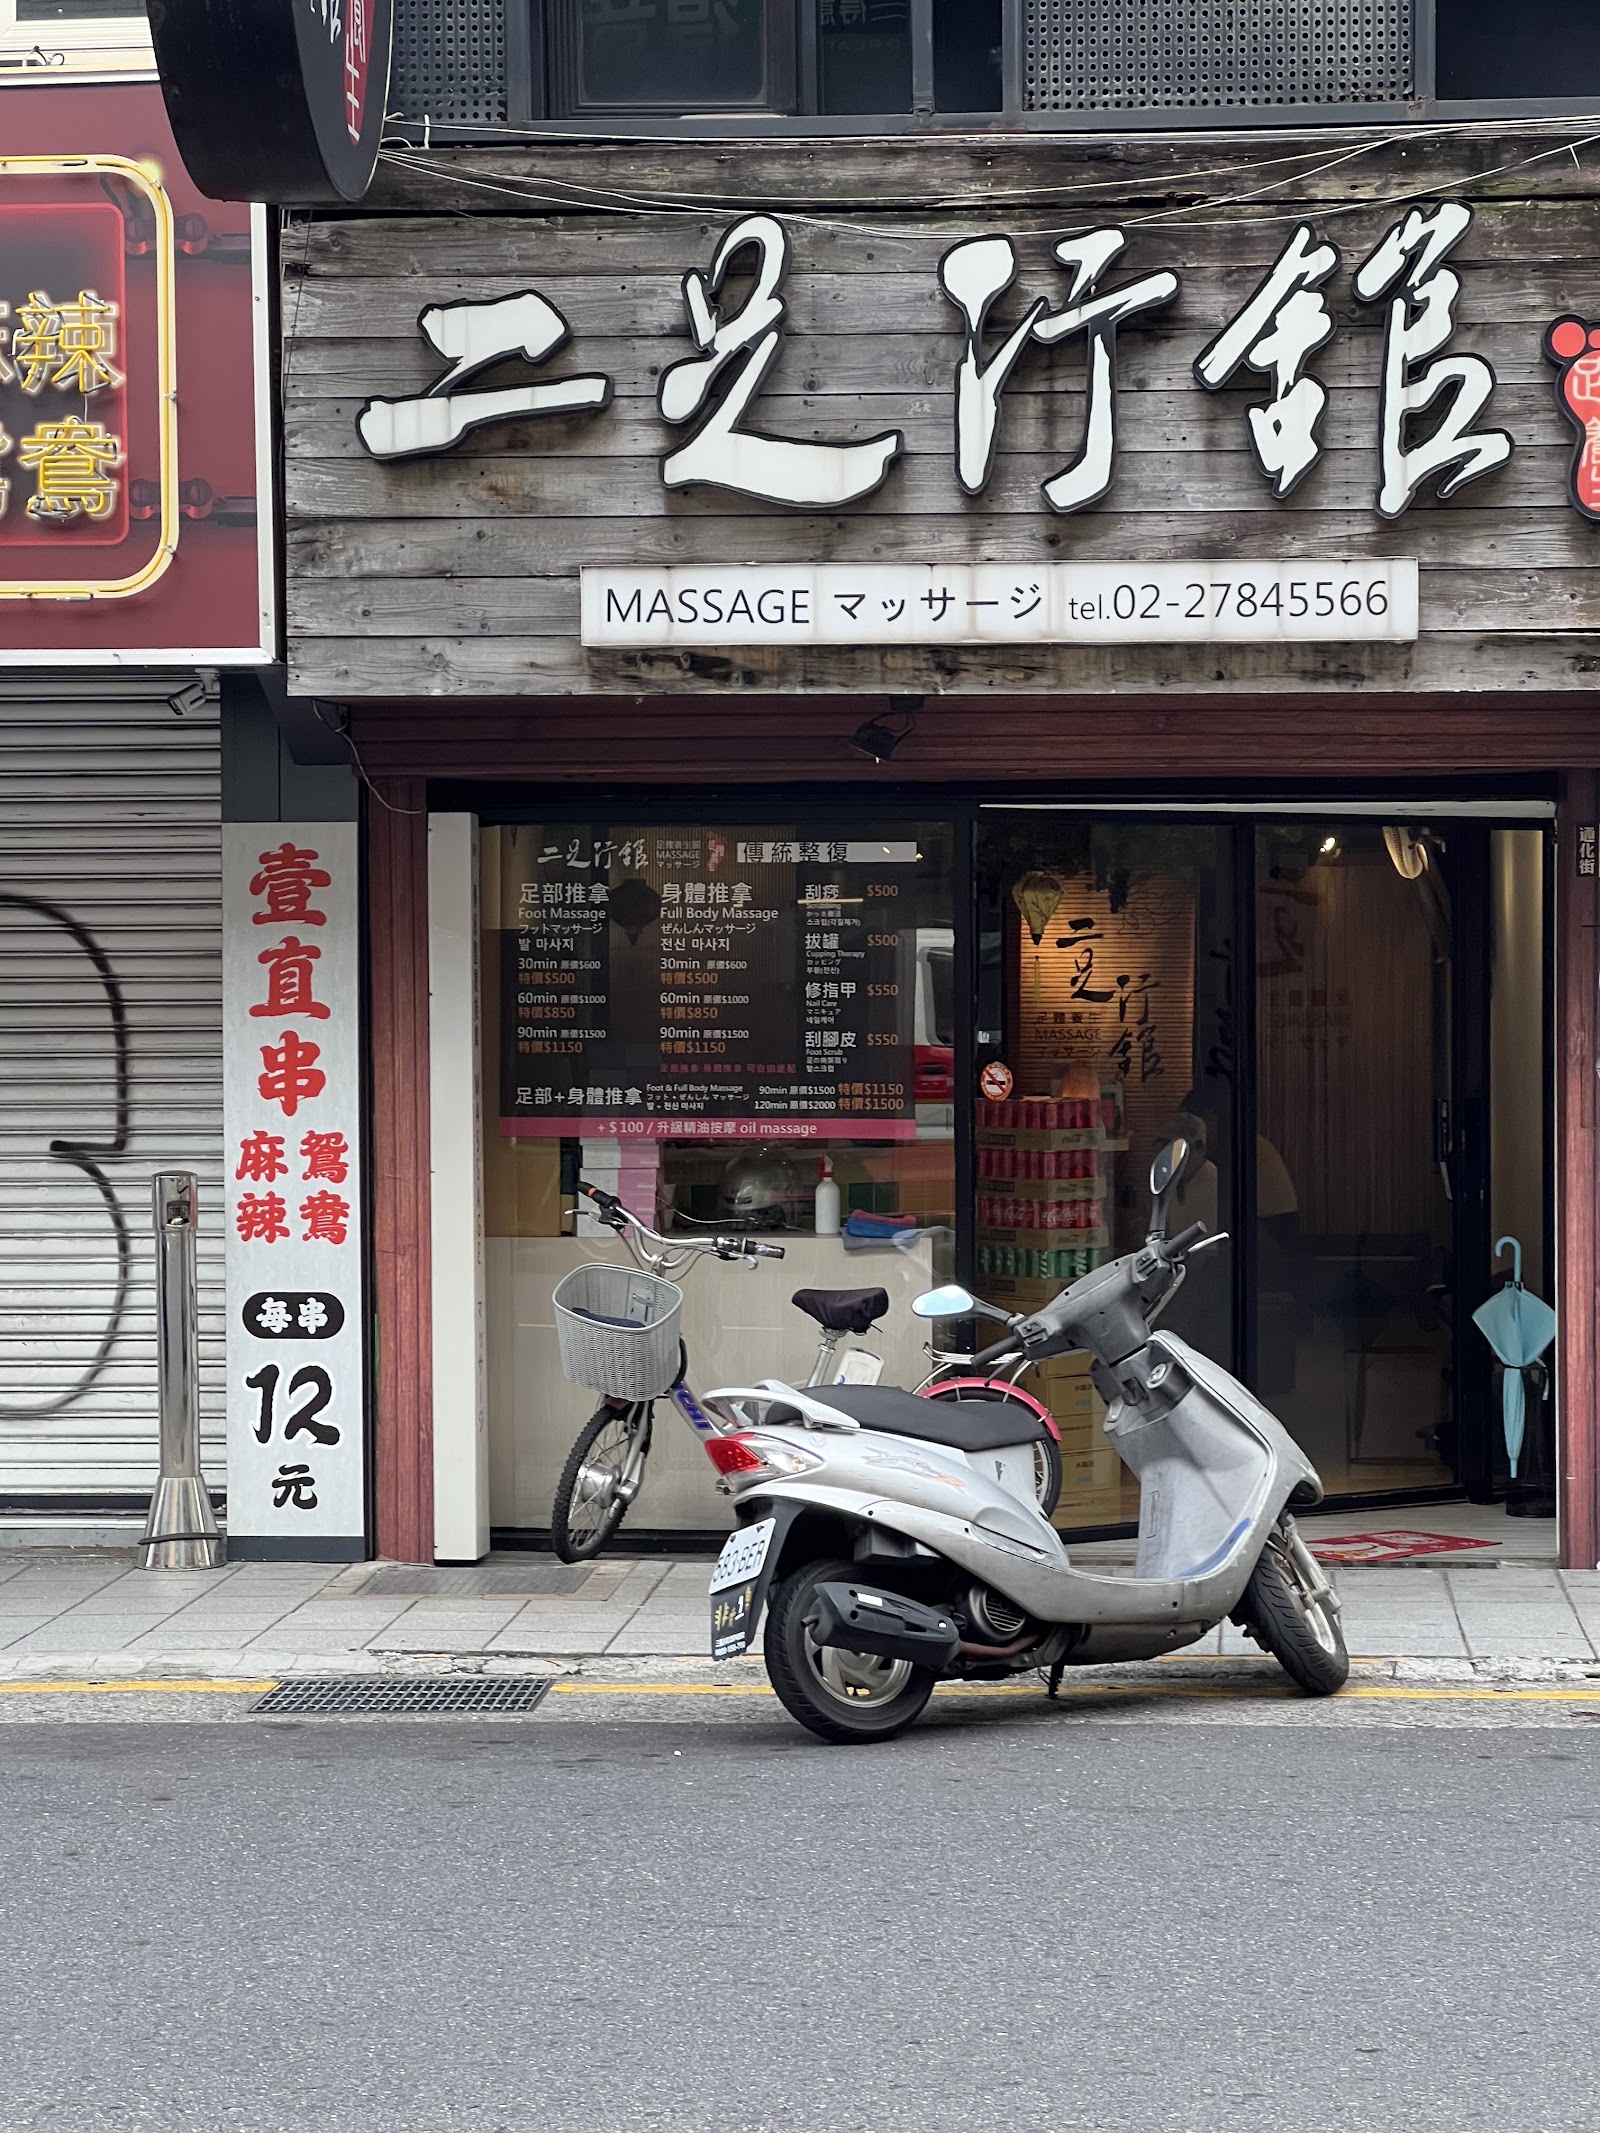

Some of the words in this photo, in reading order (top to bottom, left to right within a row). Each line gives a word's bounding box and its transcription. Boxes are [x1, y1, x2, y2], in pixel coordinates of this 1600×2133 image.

[0, 289, 124, 396] 辣
[0, 415, 124, 522] 鴦
[606, 588, 810, 624] MASSAGE
[833, 584, 1042, 623] マッサージ
[656, 850, 700, 859] MASSAGE
[743, 842, 848, 863] 傳統整復
[1579, 826, 1596, 875] 通化街
[656, 861, 701, 869] マッサージ
[519, 882, 610, 904] 足部推拿
[661, 882, 753, 905] 身體推拿
[867, 884, 899, 897] $500
[518, 907, 547, 919] Foot
[550, 907, 607, 922] Massage
[660, 907, 683, 919] Full
[686, 907, 719, 921] Body
[722, 907, 779, 922] Massage
[519, 922, 603, 935] フットマッサージ
[660, 923, 757, 935] ぜんしんマッサージ
[518, 938, 531, 952] 발
[535, 937, 574, 952] 마사지
[660, 938, 686, 951] 전신
[691, 937, 730, 952] 마사지
[804, 933, 840, 950] 拔罐
[867, 934, 899, 947] $500
[517, 957, 558, 970] 30min
[660, 957, 700, 970] 30min
[248, 842, 332, 1117] 壹直串
[517, 992, 558, 1004] 60min
[659, 992, 700, 1004] 60min
[804, 982, 857, 999] 修指甲
[867, 984, 899, 997] $550
[517, 1026, 558, 1039] 90min
[659, 1026, 700, 1039] 90min
[804, 1031, 857, 1048] 刮腳皮
[867, 1033, 899, 1046] $550
[1035, 1028, 1102, 1041] MASSAGE
[515, 1086, 643, 1105] 足部+身體推拿
[646, 1084, 664, 1092] Foot
[688, 1084, 709, 1094] Body
[710, 1084, 744, 1094] Massage
[758, 1085, 788, 1096] 90min
[837, 1082, 904, 1096] 特價$1150
[754, 1100, 788, 1110] 120min
[837, 1098, 905, 1111] 特價$1500
[740, 1121, 756, 1134] oil
[760, 1124, 818, 1137] massage
[256, 1297, 330, 1336] 每串
[246, 1363, 342, 1447] 12
[271, 1463, 319, 1510] 元
